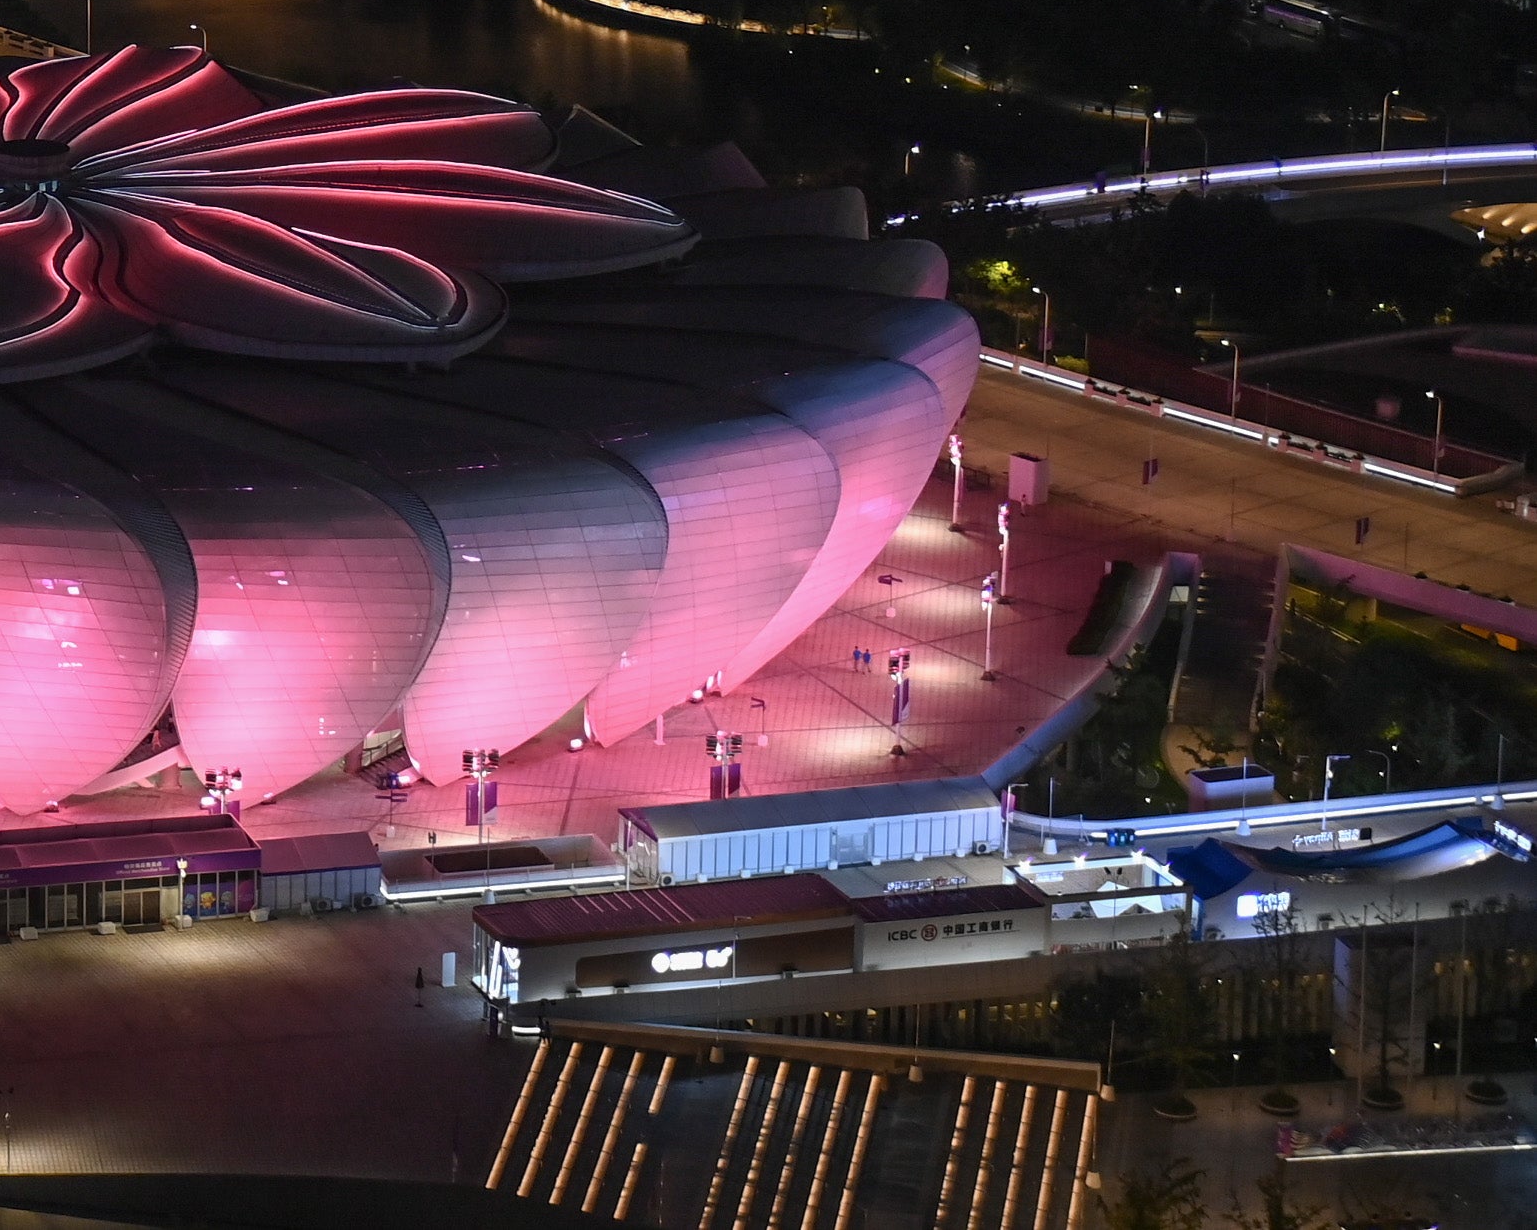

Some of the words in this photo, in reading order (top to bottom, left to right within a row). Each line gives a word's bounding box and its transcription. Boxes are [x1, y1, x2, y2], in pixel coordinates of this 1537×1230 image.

[887, 929, 917, 941] ICBC
[942, 919, 1013, 936] 中国工商银行
